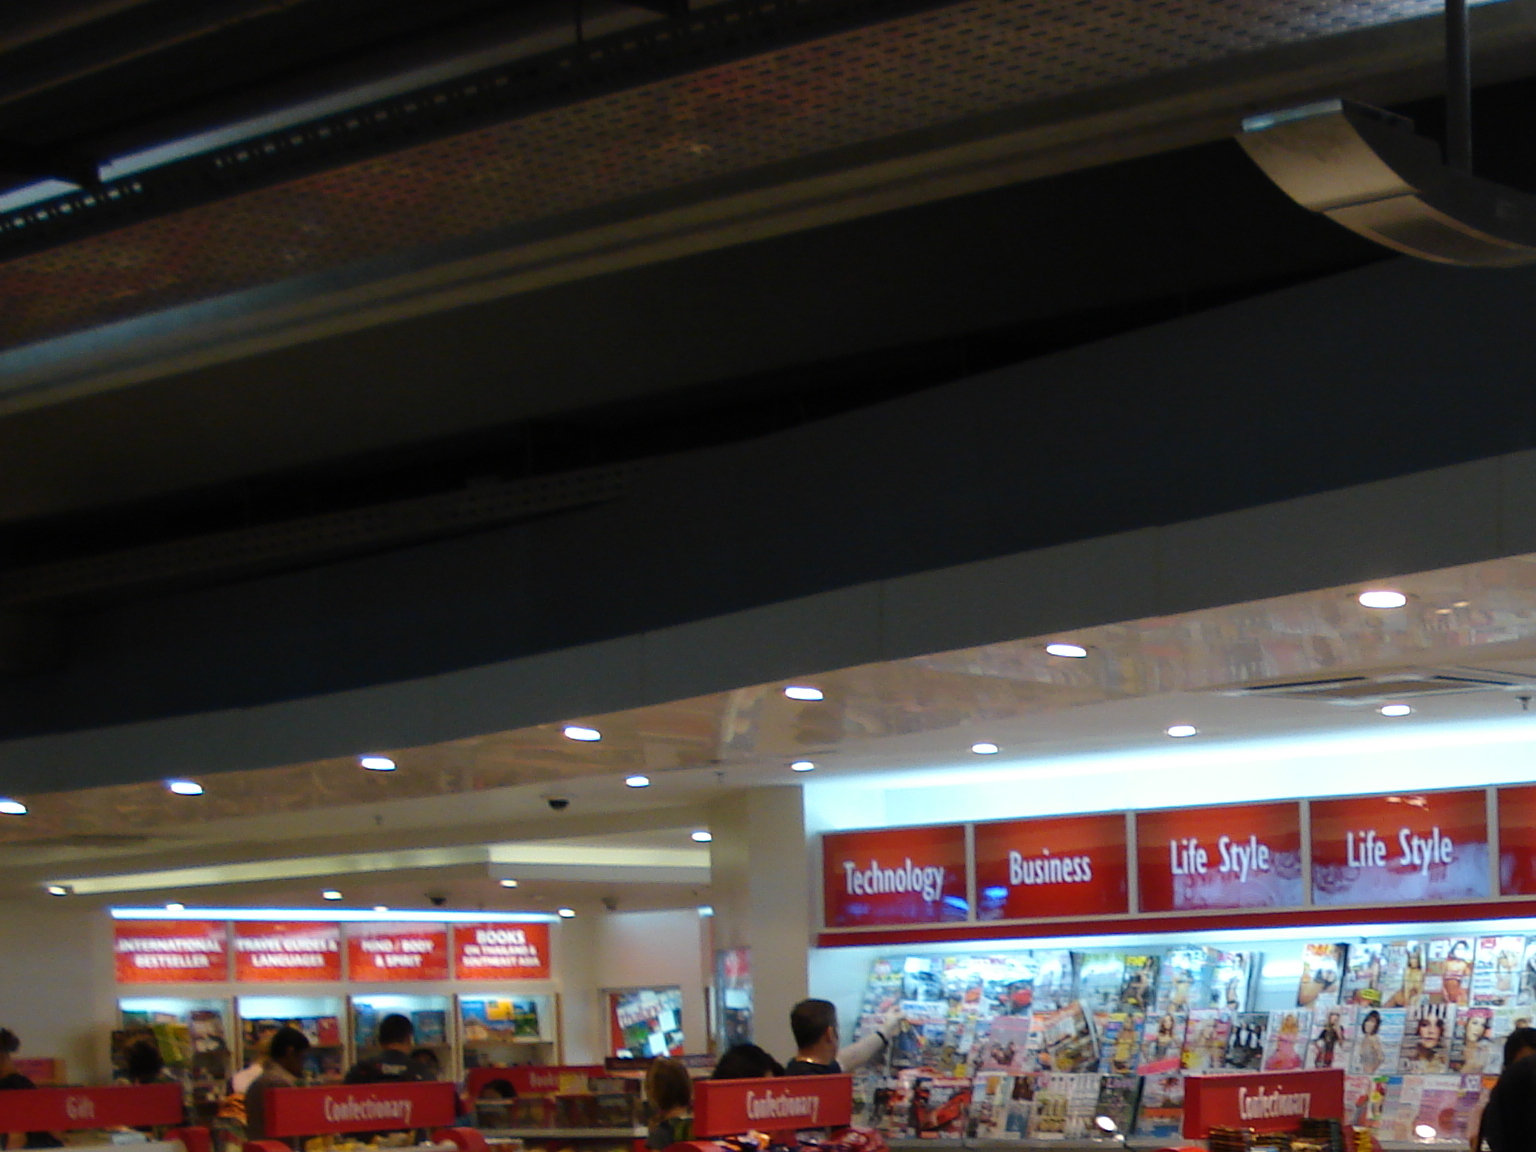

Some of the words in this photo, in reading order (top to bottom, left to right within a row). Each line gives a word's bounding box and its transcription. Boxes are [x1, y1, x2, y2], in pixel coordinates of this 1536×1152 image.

[1170, 838, 1208, 875] Life
[1218, 835, 1270, 883] Style
[1346, 830, 1387, 868] Life
[1399, 826, 1454, 876] Style
[843, 857, 946, 902] Technology
[1009, 848, 1092, 885] Business
[118, 936, 222, 953] INTERNATIONAL
[236, 936, 281, 953] TRAVEL
[283, 937, 327, 953] GUIDES
[401, 938, 435, 953] BODY
[475, 928, 526, 945] BOOKS
[134, 953, 211, 968] BESTSELLER
[251, 953, 326, 968] LANGUAGES
[385, 954, 423, 968] SPIRIT
[66, 1095, 96, 1121] Gift
[324, 1094, 414, 1127] Confectionary
[746, 1088, 820, 1124] Confectionary
[1238, 1085, 1311, 1121] Confectionary
